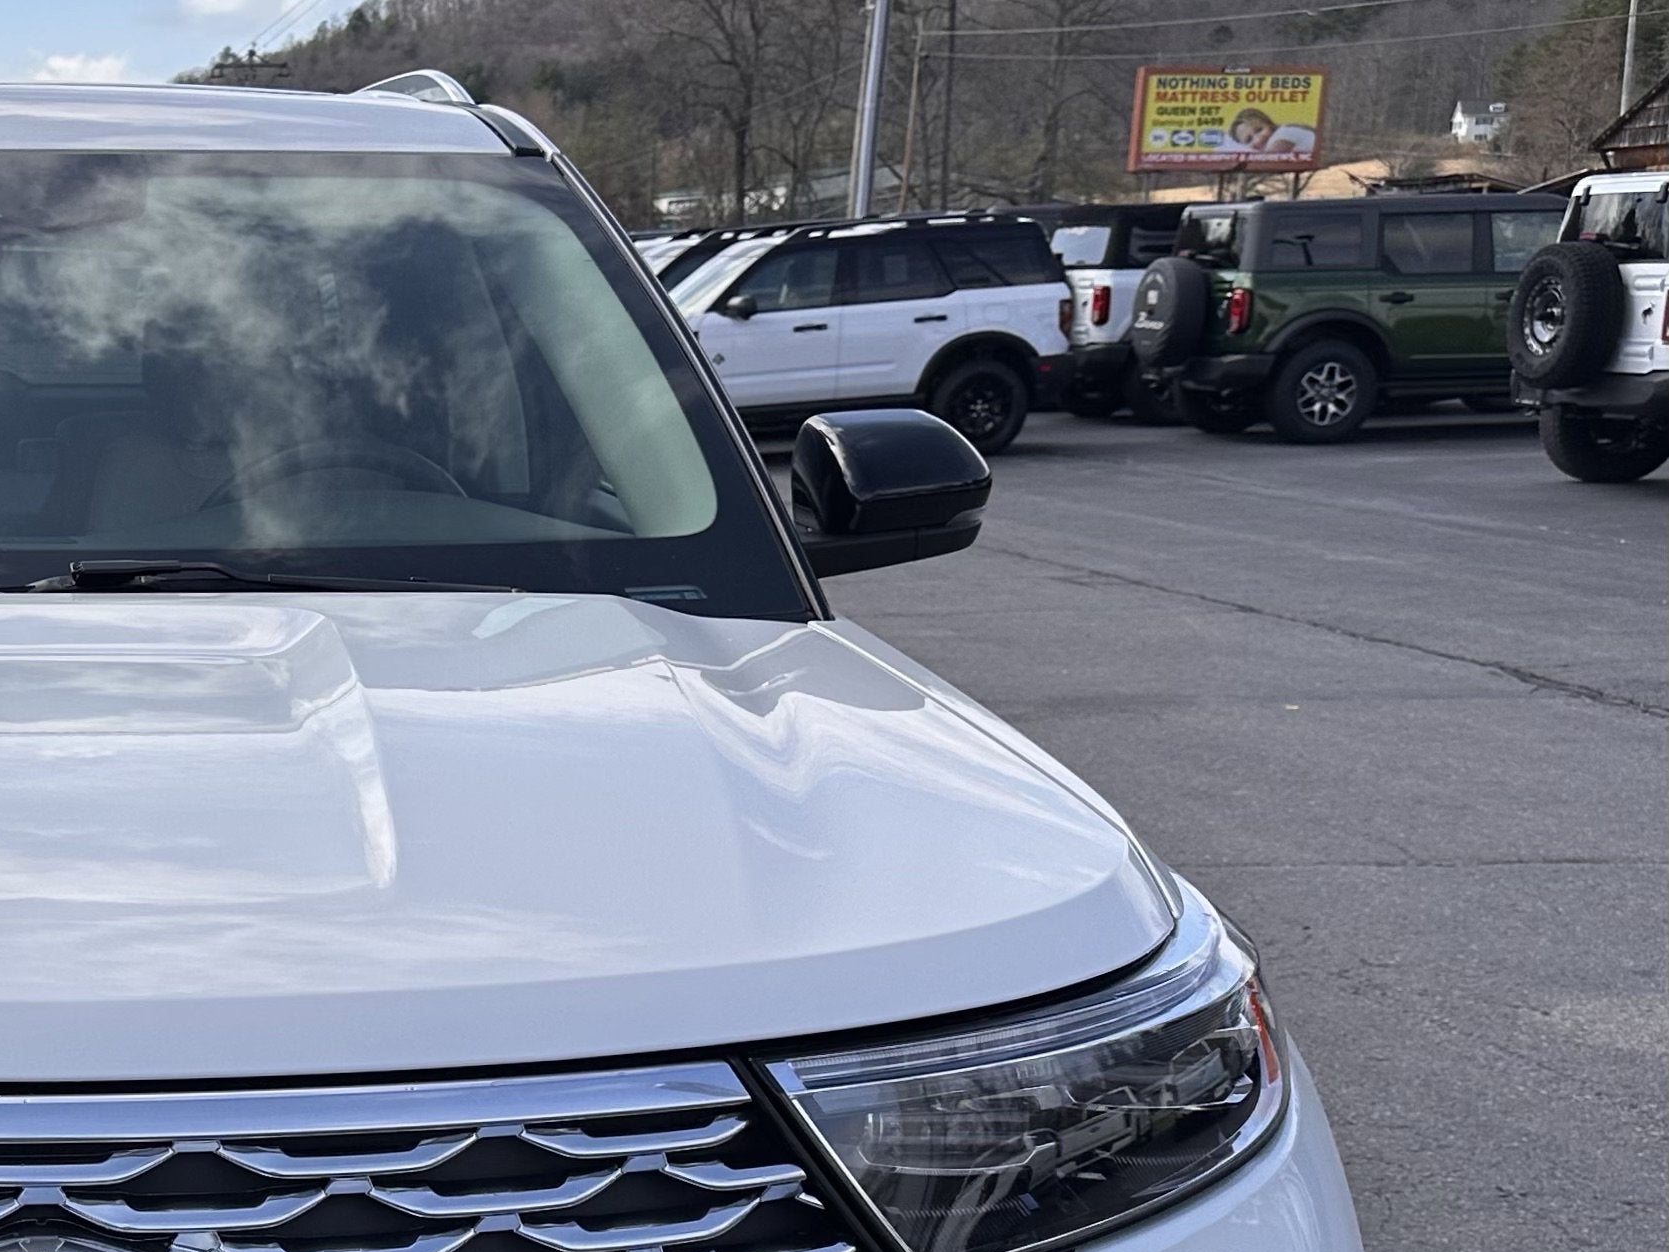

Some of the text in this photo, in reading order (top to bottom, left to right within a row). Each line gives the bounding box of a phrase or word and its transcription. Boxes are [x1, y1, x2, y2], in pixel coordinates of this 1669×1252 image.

[1156, 77, 1312, 89] NOTHING BUT BEDS
[1155, 90, 1310, 103] MATTRESS OUTLET
[1156, 106, 1222, 116] QUEEN SET
